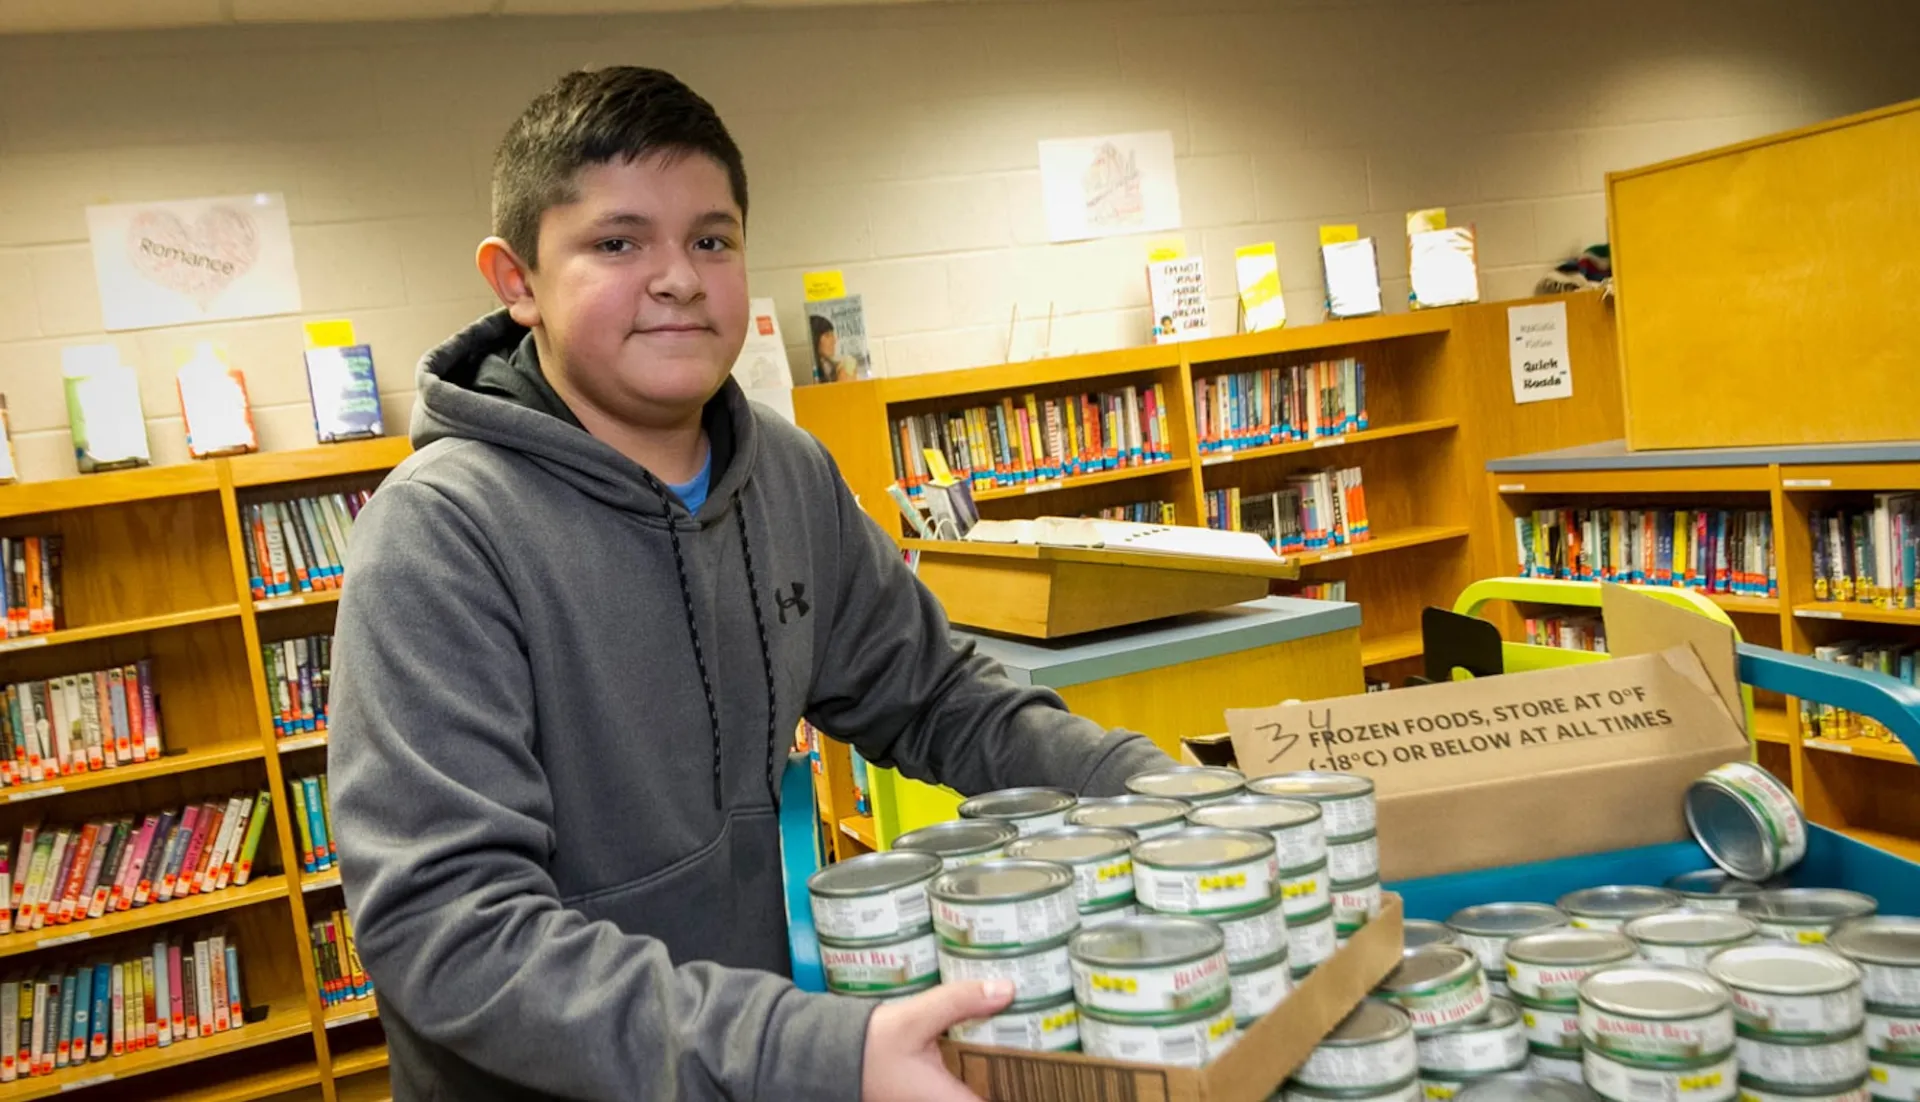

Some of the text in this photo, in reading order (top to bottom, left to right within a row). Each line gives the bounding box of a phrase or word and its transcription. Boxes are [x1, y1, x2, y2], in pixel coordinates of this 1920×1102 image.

[140, 238, 234, 276] Romance
[1523, 359, 1558, 372] Quick
[1308, 721, 1400, 748] FROZEN
[1403, 709, 1491, 735] FOODS,
[1492, 697, 1569, 722] STORE
[1574, 692, 1602, 711] AT
[1393, 744, 1428, 764] OR
[1431, 732, 1512, 758] BELOW
[1519, 726, 1549, 745] AT
[1556, 720, 1598, 741] ALL
[1597, 708, 1673, 734] TIMES
